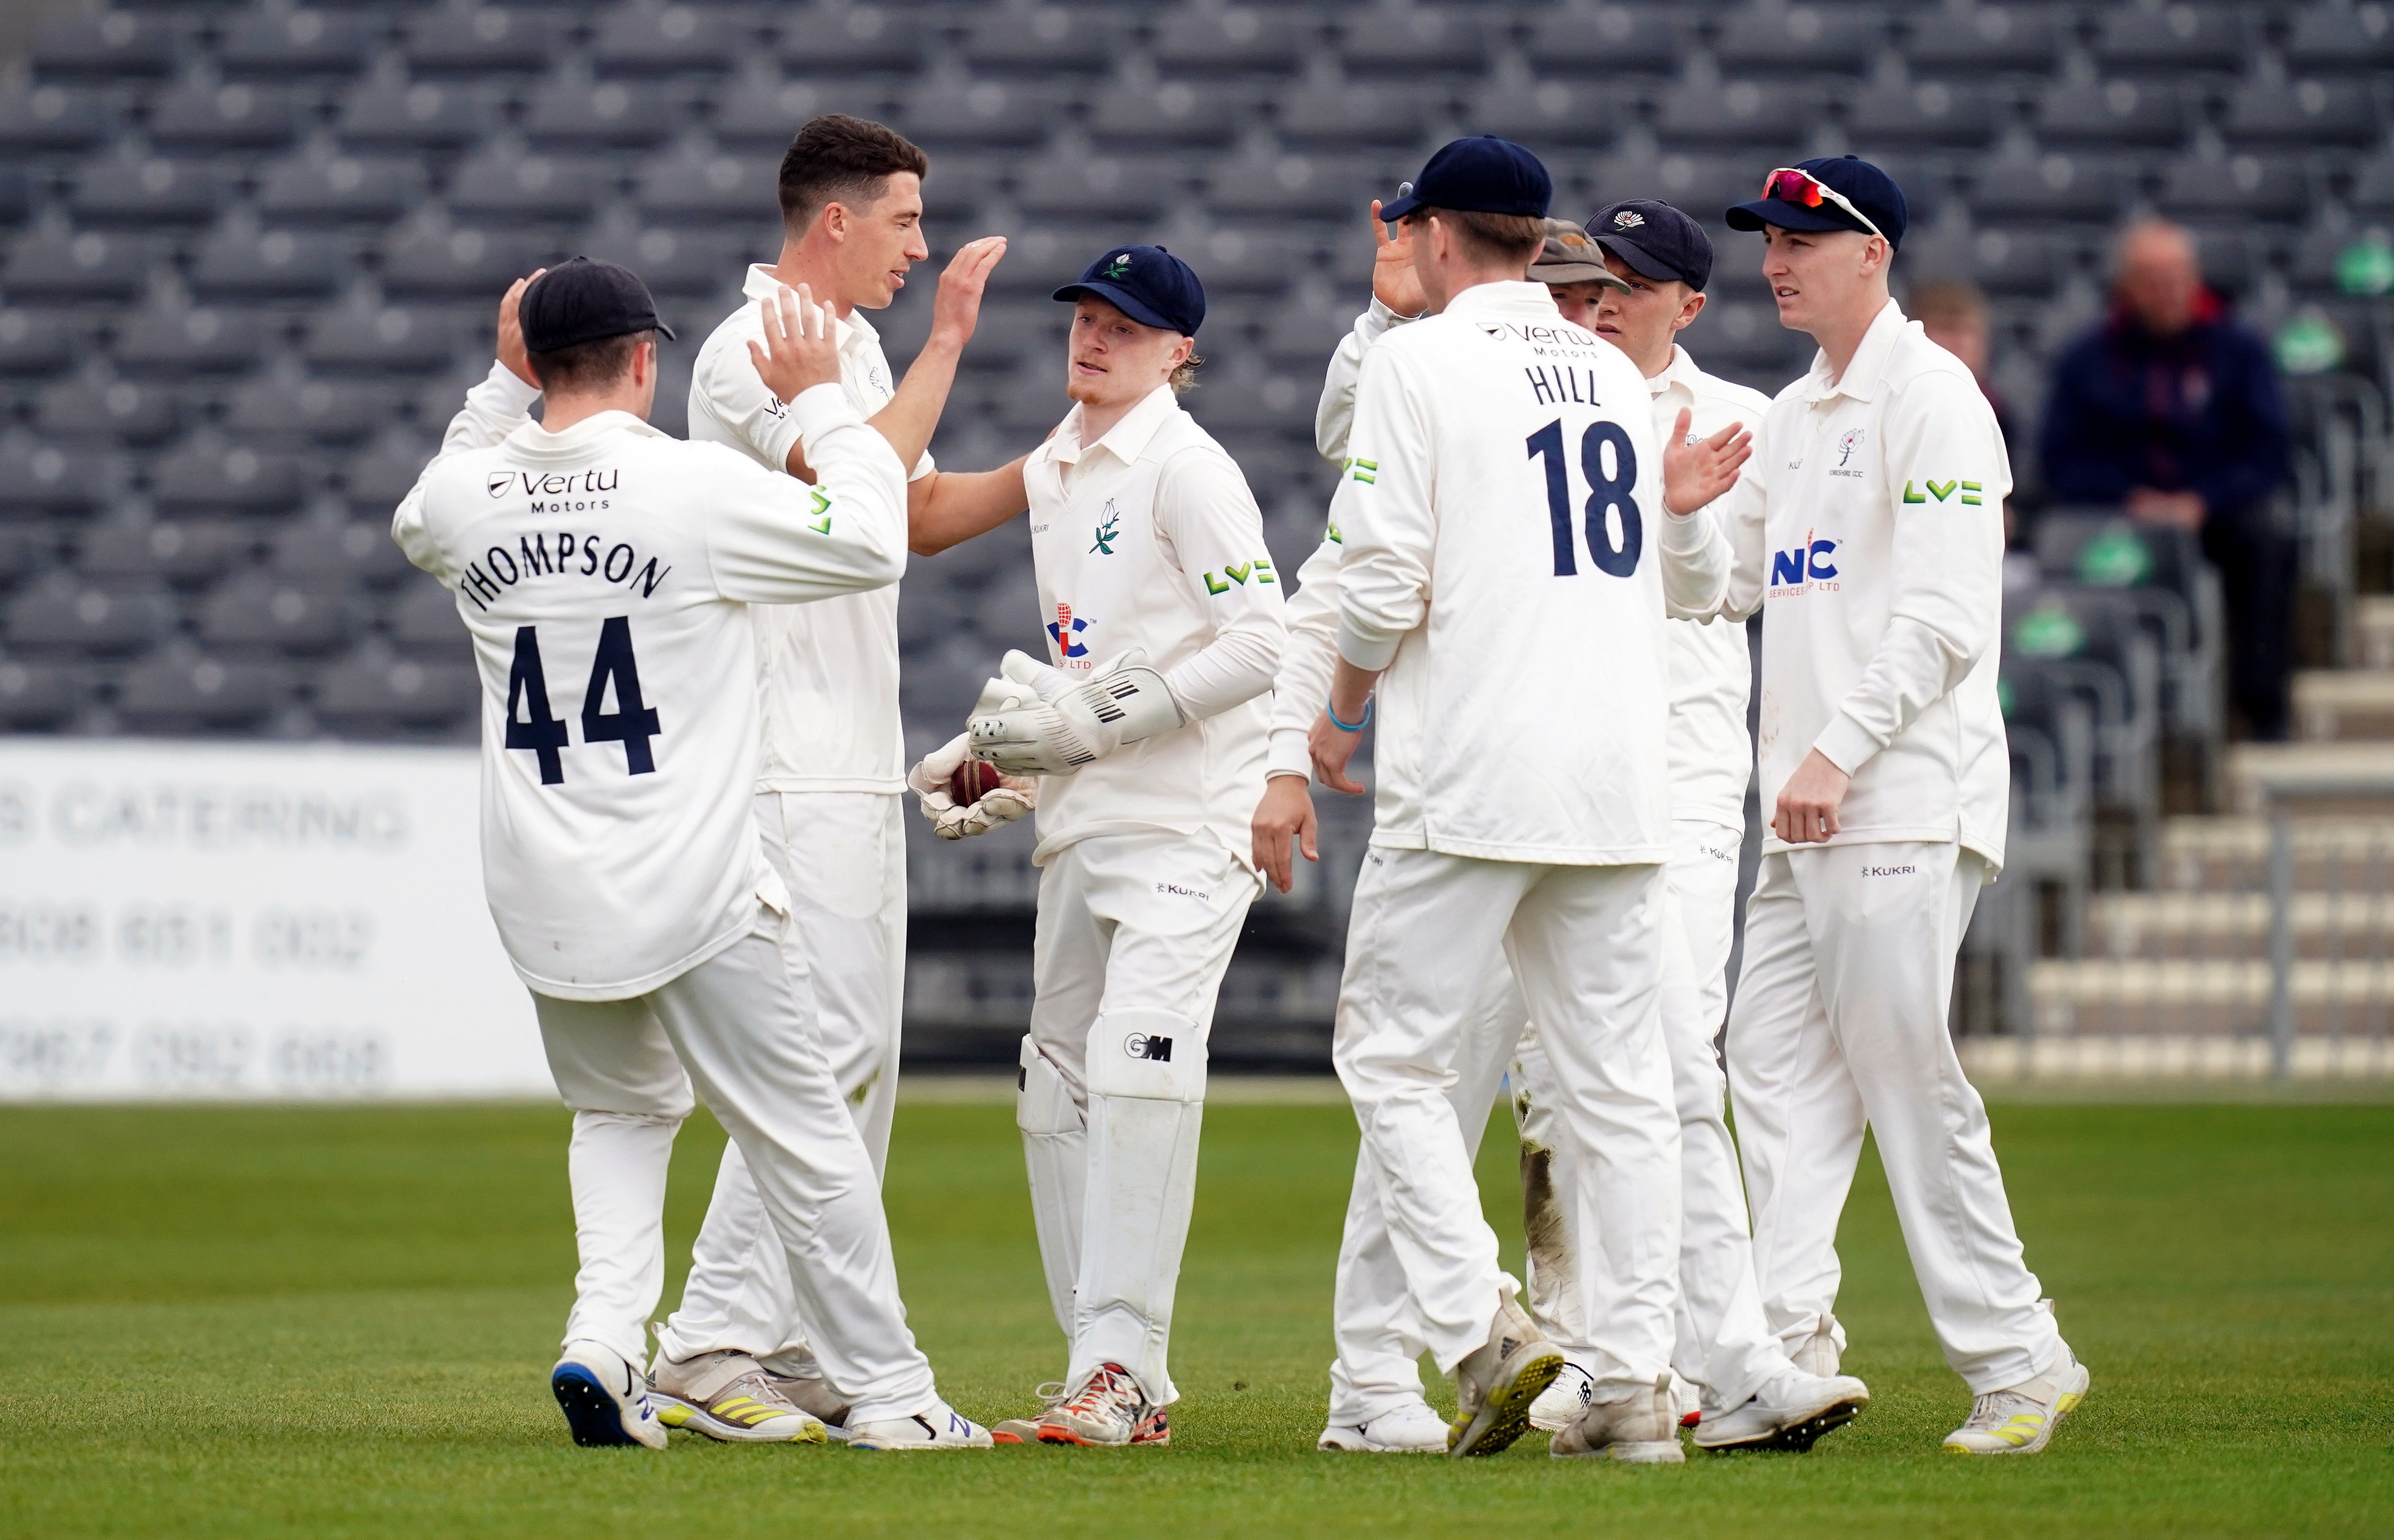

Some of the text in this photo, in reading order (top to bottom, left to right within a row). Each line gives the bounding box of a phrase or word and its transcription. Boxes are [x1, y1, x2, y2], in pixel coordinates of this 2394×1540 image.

[1505, 323, 1595, 345] Vertu
[1534, 346, 1598, 359] Motors
[1525, 365, 1601, 407] HILL
[523, 469, 618, 494] Vertu
[532, 500, 609, 513] Motors
[1526, 417, 1642, 577] 18
[462, 533, 672, 612] THOMPSON
[1769, 587, 1803, 598] SERVICES
[1820, 582, 1840, 591] LTD
[1070, 660, 1091, 669] LTD
[505, 615, 661, 785] 44
[52, 785, 409, 852] CATERING
[1872, 866, 1915, 876] KUKRI
[1124, 1032, 1172, 1062] GM
